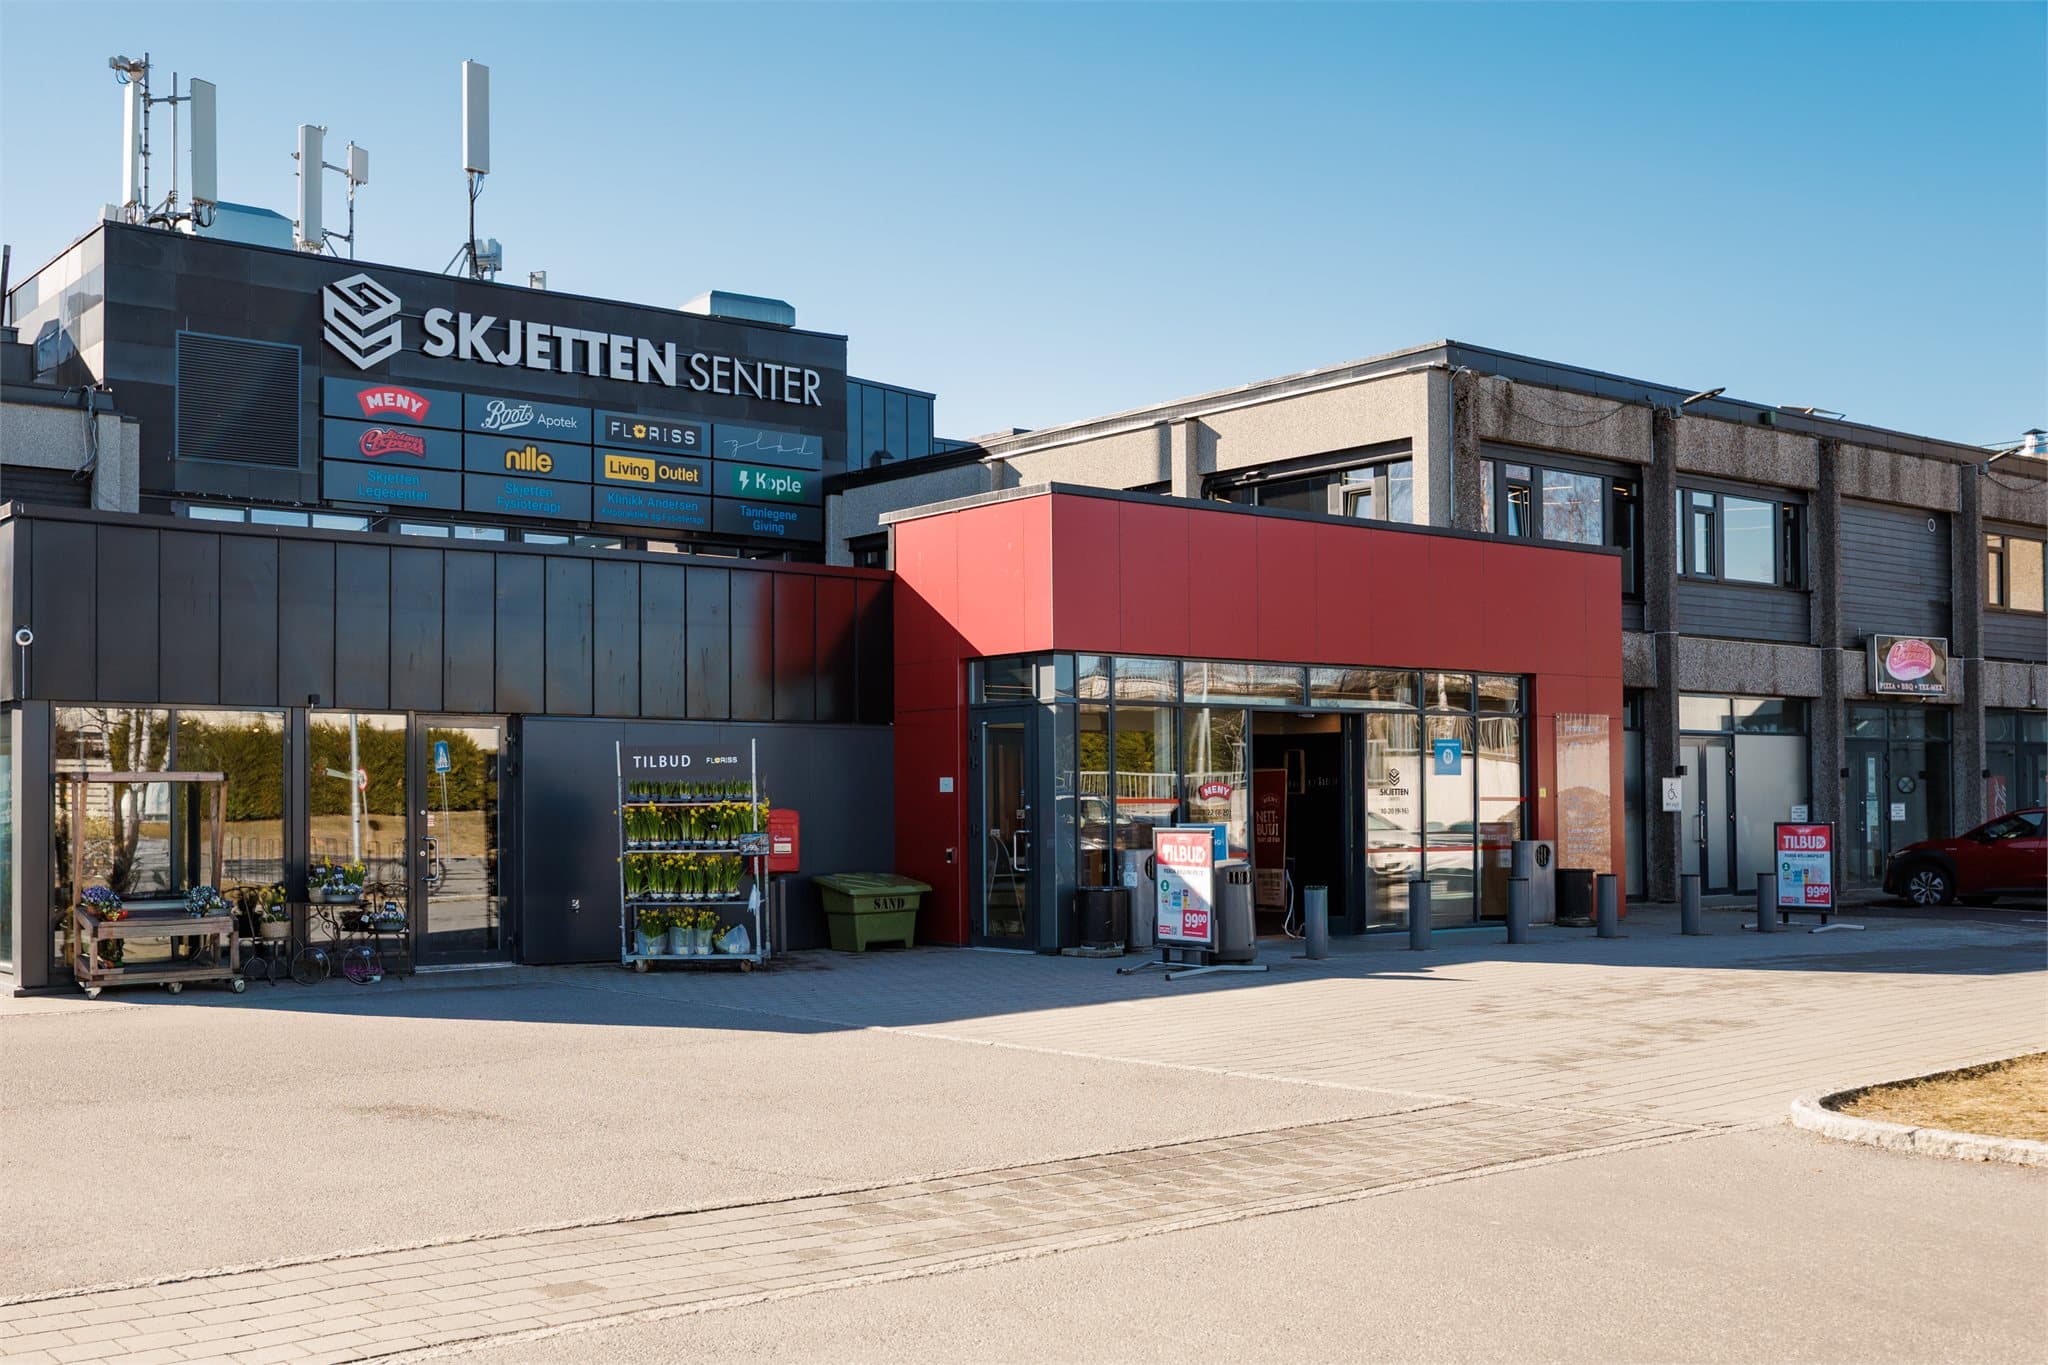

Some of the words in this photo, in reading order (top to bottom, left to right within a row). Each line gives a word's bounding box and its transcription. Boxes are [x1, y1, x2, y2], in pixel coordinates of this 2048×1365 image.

[422, 307, 676, 387] SKJETTEN
[689, 352, 822, 407] SENTER
[366, 392, 423, 413] MENY
[481, 400, 534, 430] Boots
[537, 413, 577, 428] Apotek
[505, 445, 553, 473] nille
[367, 469, 420, 486] Skjetten
[609, 460, 650, 480] Living
[659, 465, 699, 482] Outlet
[358, 482, 429, 501] Legesenter
[505, 482, 553, 498] Skjetten
[755, 472, 801, 495] Kople
[497, 496, 561, 513] Fysioterapi
[607, 491, 643, 505] Klinikk
[648, 496, 698, 512] Andersen
[740, 505, 797, 522] Tannlegene
[752, 520, 785, 536] Giving
[633, 755, 691, 768] TILBUD
[1204, 785, 1230, 796] MENY
[1380, 788, 1409, 796] SKJETTEN
[1784, 835, 1827, 849] TILBUD
[1162, 844, 1206, 863] TILBUD
[873, 897, 905, 910] SAND
